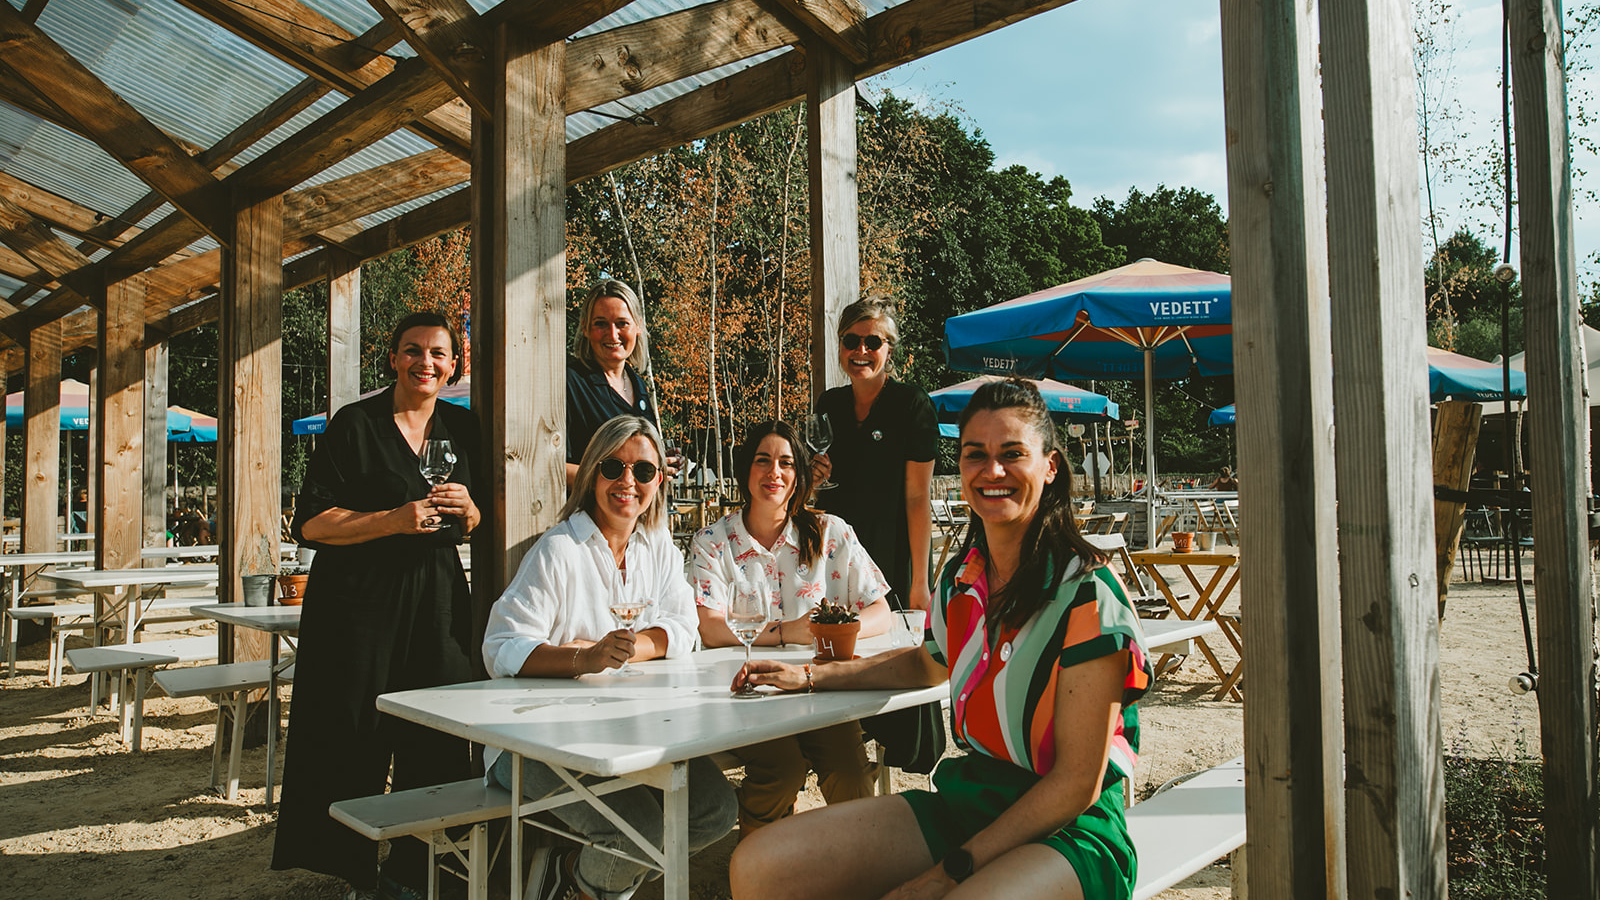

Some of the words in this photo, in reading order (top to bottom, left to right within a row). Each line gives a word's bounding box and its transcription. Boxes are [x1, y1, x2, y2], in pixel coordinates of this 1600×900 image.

[1149, 301, 1212, 316] VEDETT
[983, 357, 1015, 370] VEDETT
[72, 417, 89, 425] VED
[282, 584, 298, 597] 23
